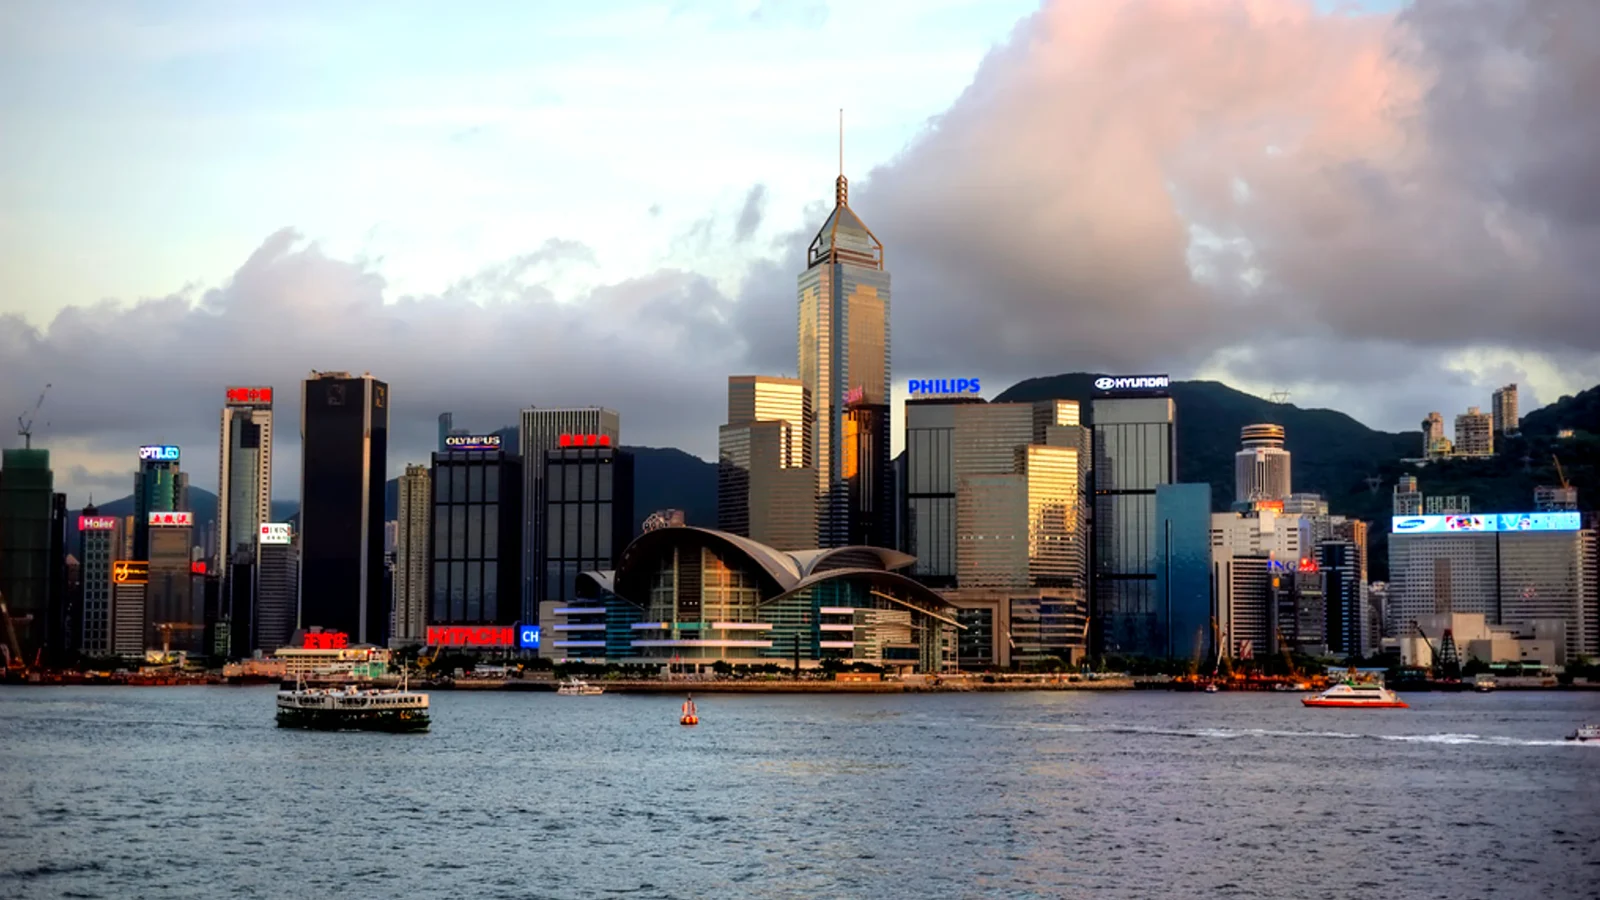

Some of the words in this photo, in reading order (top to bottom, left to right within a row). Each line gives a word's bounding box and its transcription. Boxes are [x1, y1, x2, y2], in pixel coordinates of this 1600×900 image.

[908, 378, 980, 394] PHILIPS
[1115, 377, 1168, 388] HYUNDAI
[446, 436, 500, 445] OLYMPUS
[84, 518, 114, 529] Haier
[1267, 560, 1296, 574] ING
[428, 627, 513, 645] HITACHI
[522, 631, 539, 642] CH
